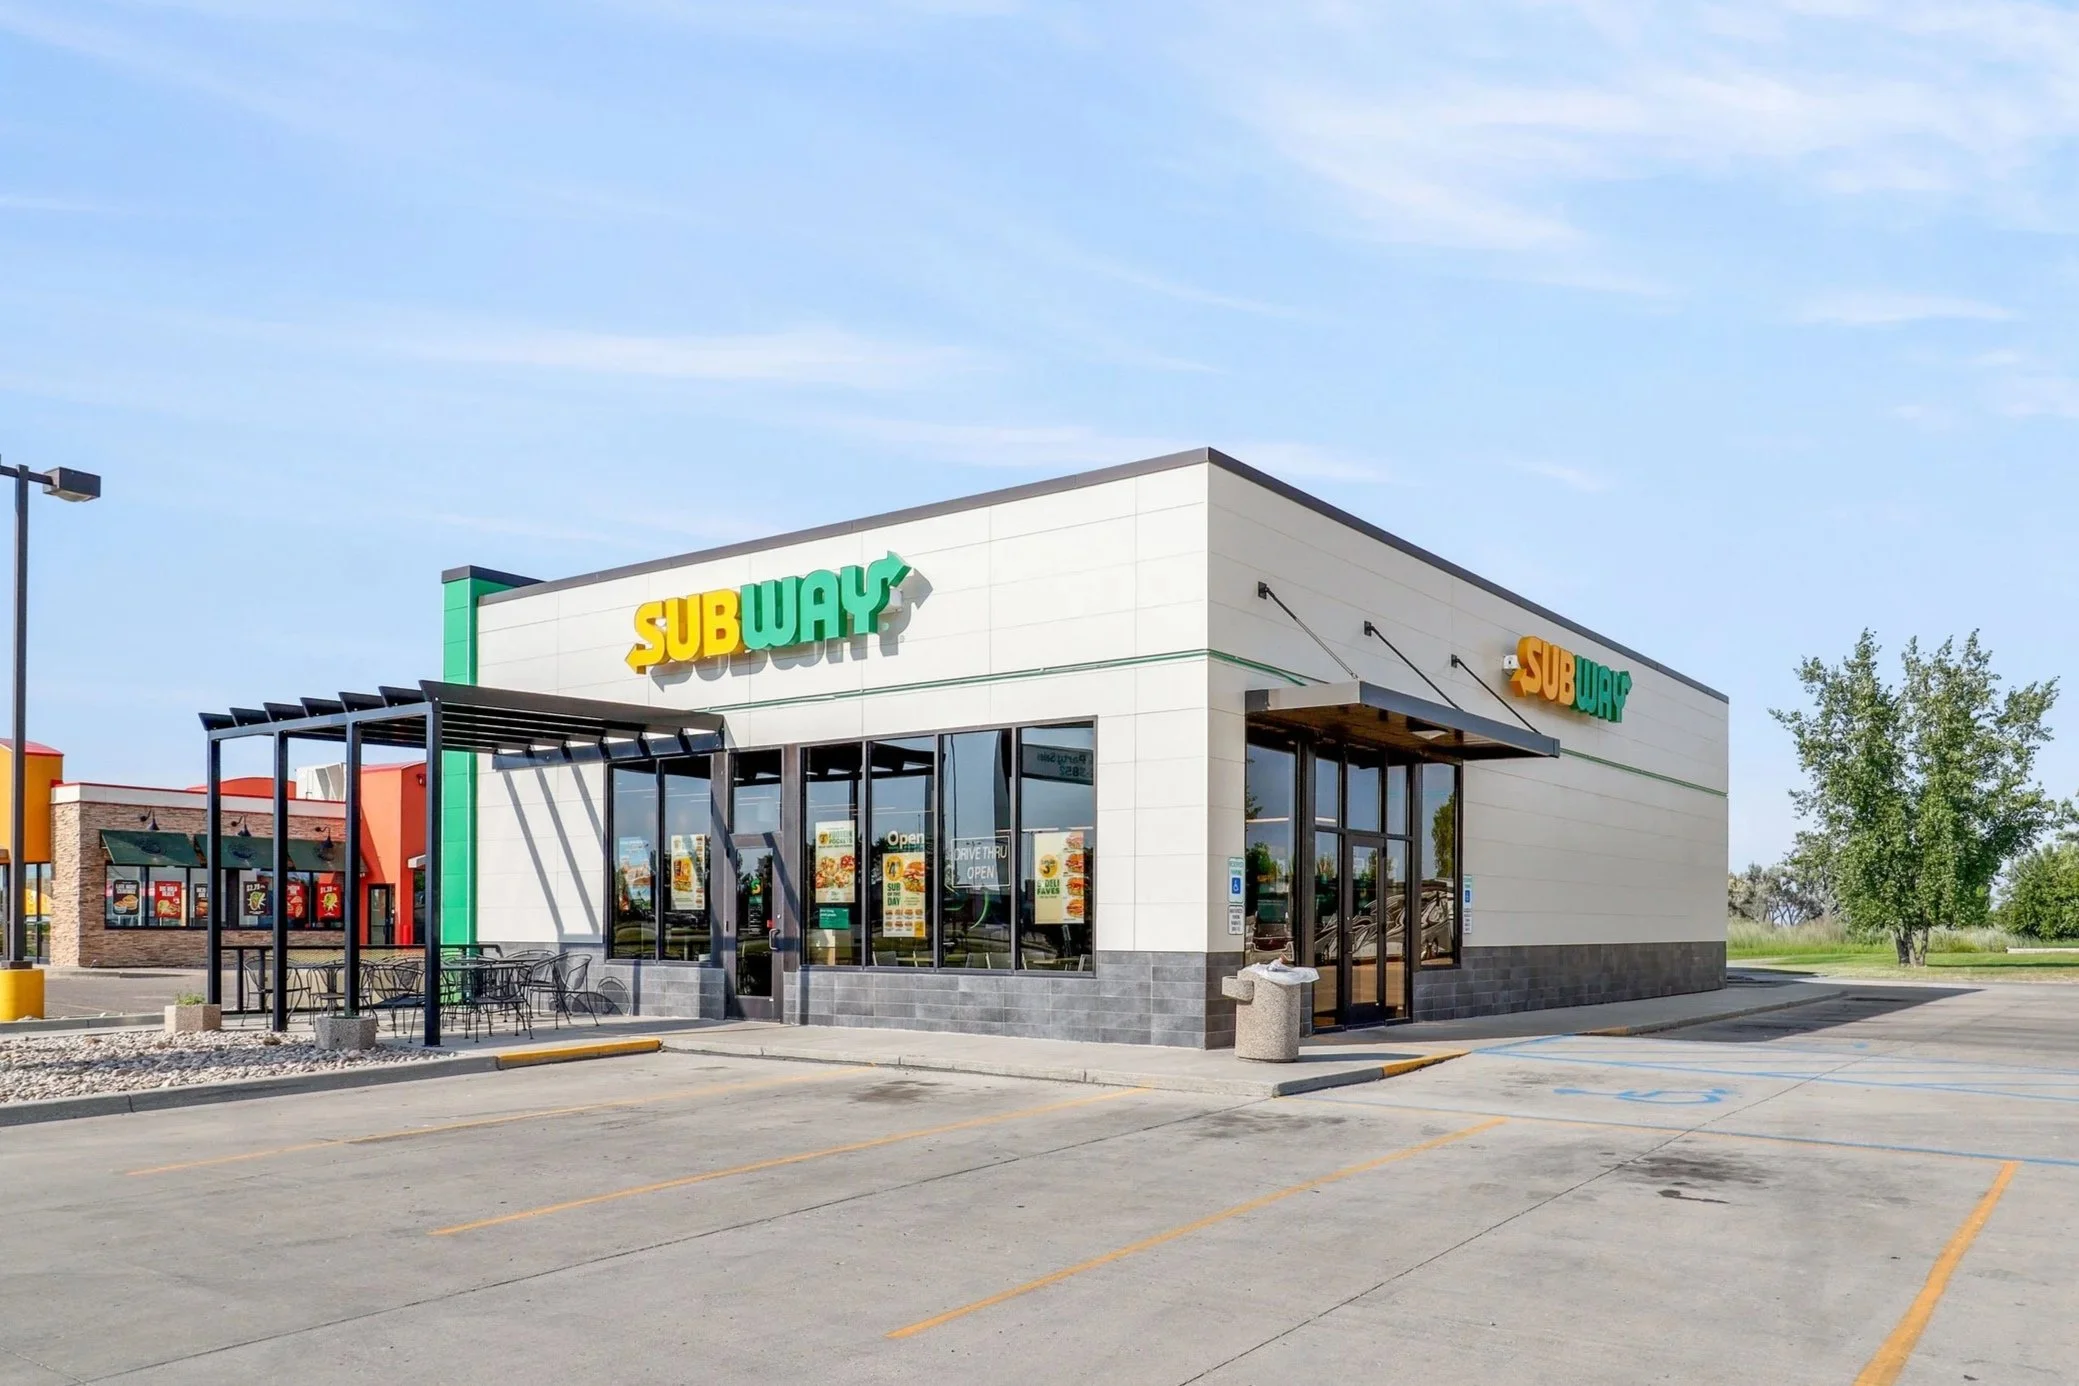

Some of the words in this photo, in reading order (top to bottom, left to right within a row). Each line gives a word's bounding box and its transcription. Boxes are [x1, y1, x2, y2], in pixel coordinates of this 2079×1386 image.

[625, 550, 912, 675] SUBWAY
[1510, 635, 1633, 723] SUBWAY
[887, 830, 925, 849] Open
[953, 846, 981, 861] DRIVE
[982, 844, 1008, 860] THRU
[966, 865, 996, 880] OPEN
[887, 882, 901, 892] SUB
[1037, 887, 1060, 896] FAVES
[887, 897, 900, 906] DAY
